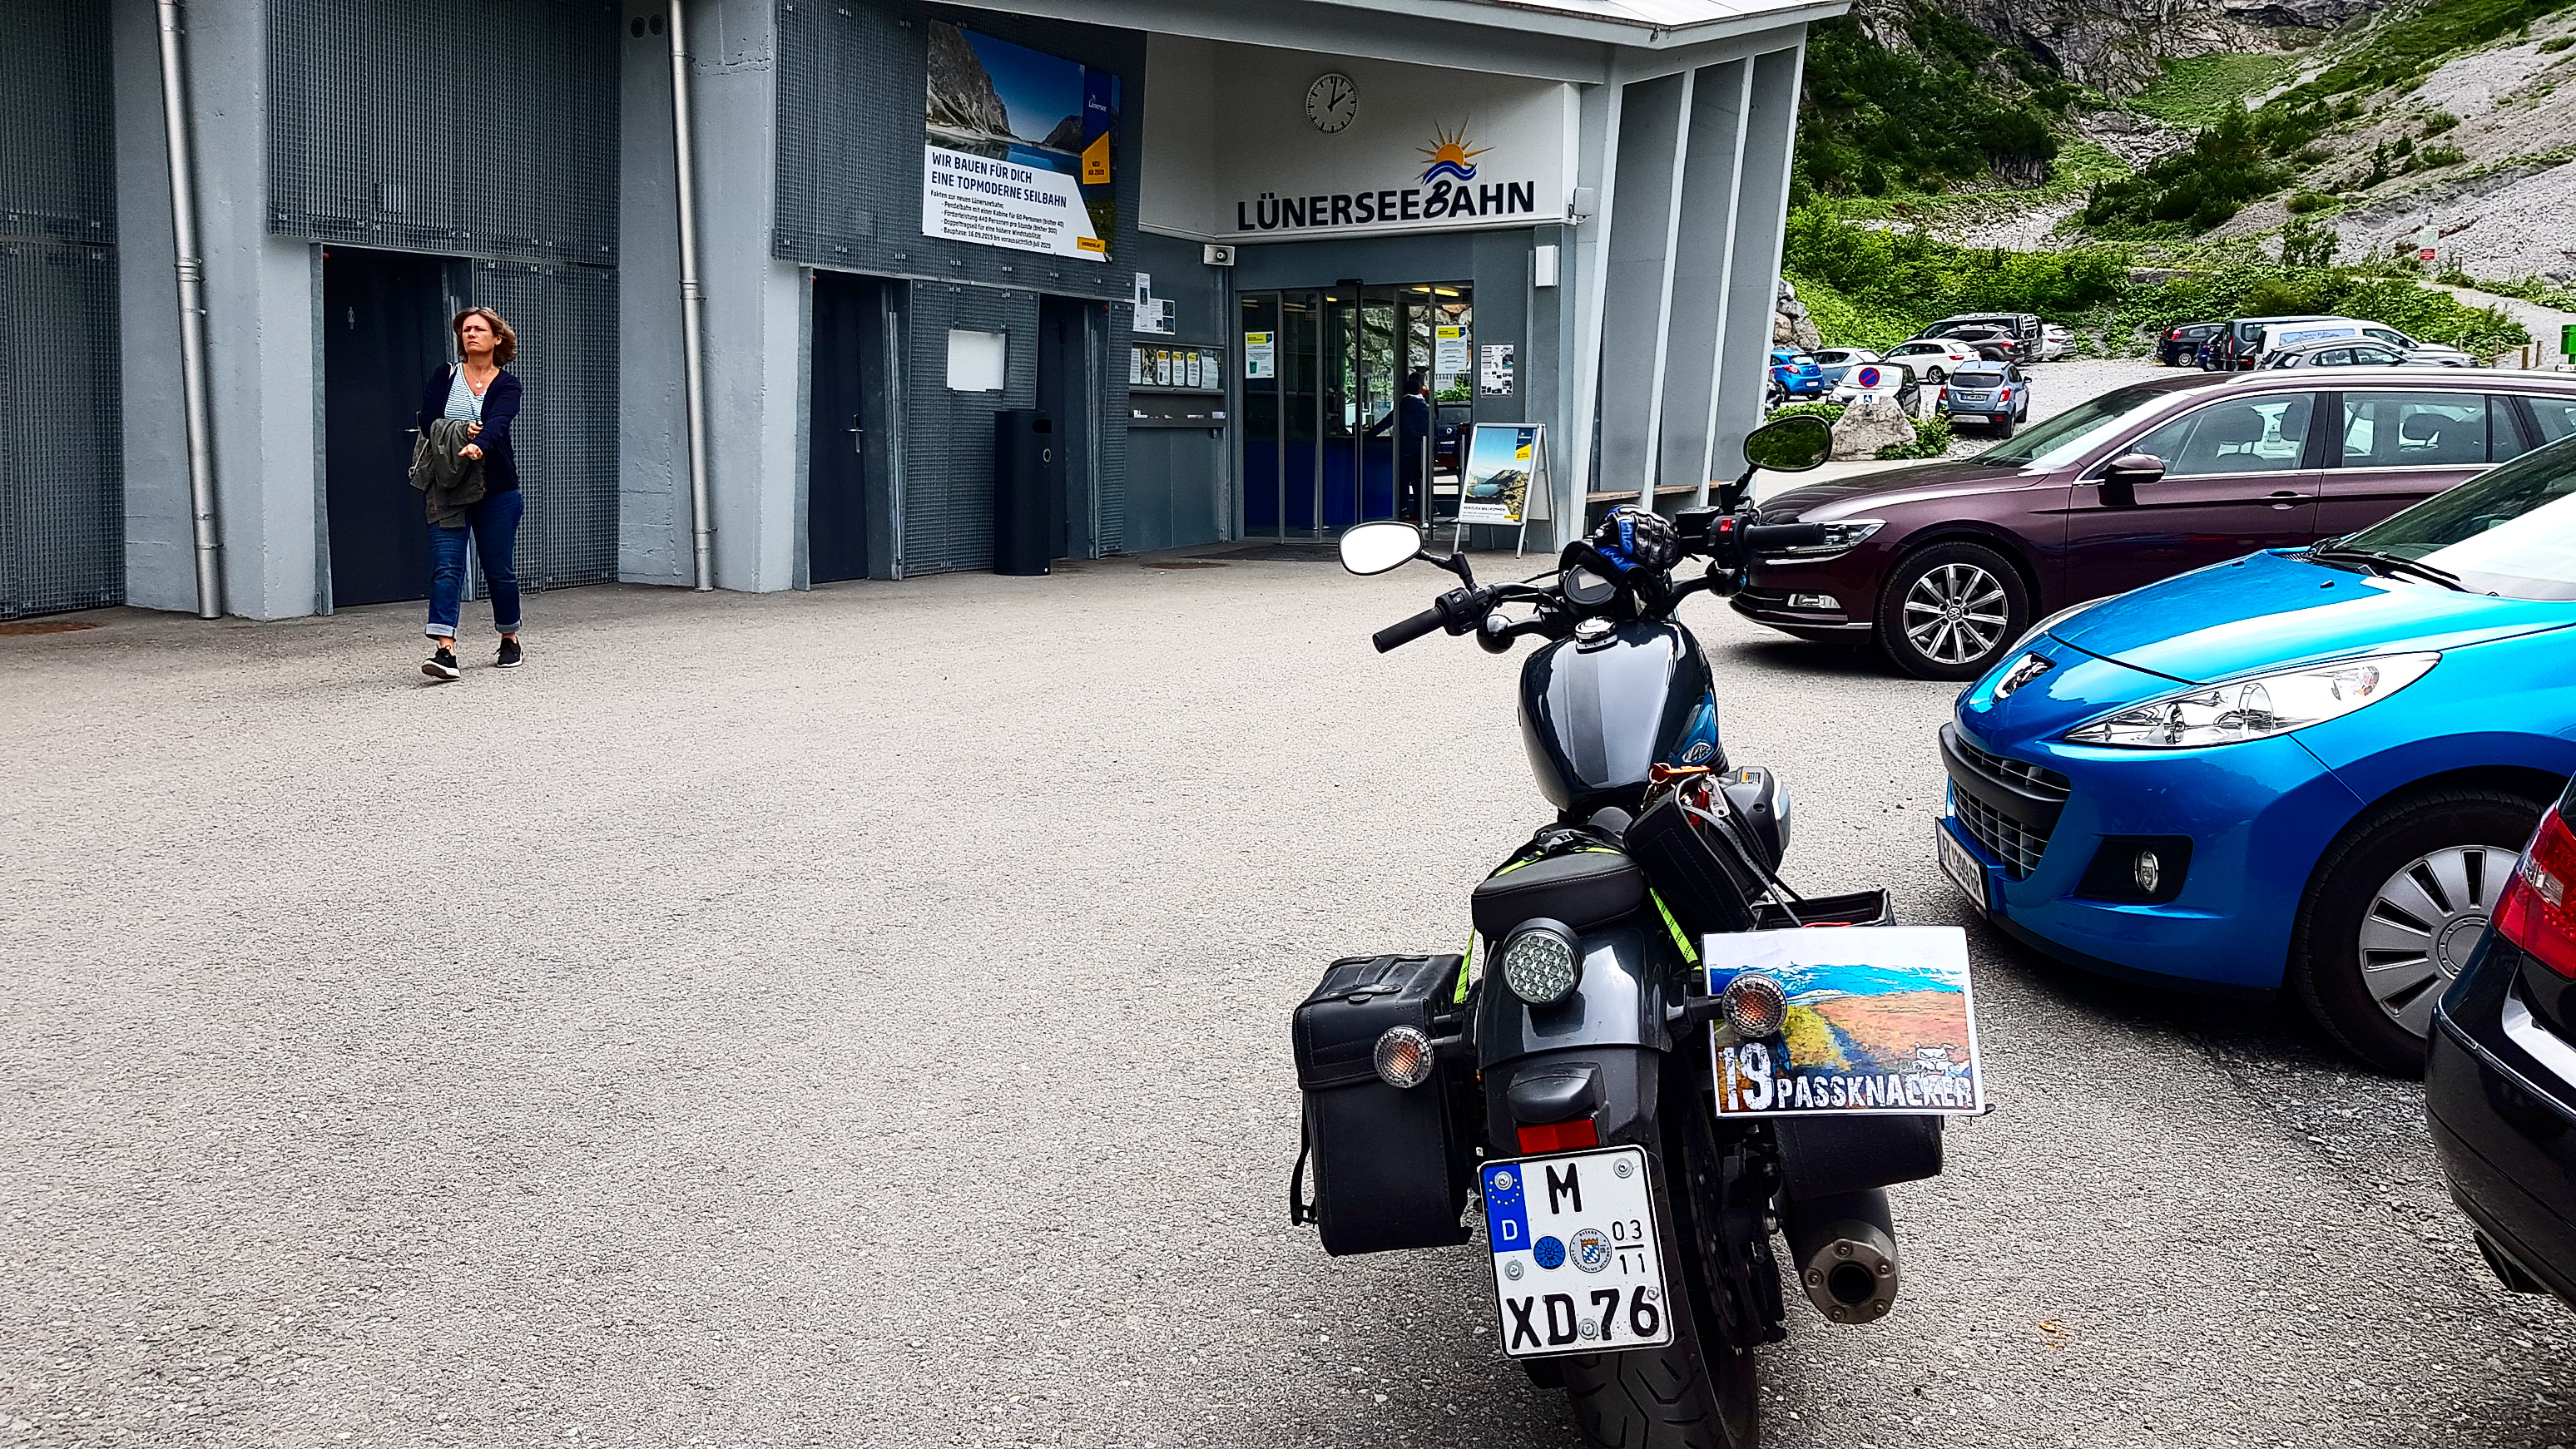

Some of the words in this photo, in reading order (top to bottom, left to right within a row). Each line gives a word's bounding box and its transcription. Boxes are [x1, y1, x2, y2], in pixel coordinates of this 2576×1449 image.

[933, 152, 951, 168] WIR
[955, 157, 987, 175] BAUEN
[990, 163, 1008, 179] FÜR
[1011, 169, 1032, 184] DICH
[932, 171, 954, 186] EINE
[957, 176, 1021, 199] TOPMODERNE
[1024, 189, 1067, 208] SEILBAHN
[1237, 180, 1535, 231] LÜNERSEEBAHN
[1718, 1042, 1774, 1110] 19
[1778, 1074, 1973, 1109] PASSKNACKER
[1546, 1162, 1582, 1214] M
[1501, 1219, 1518, 1241] D
[1619, 1253, 1645, 1275] 11
